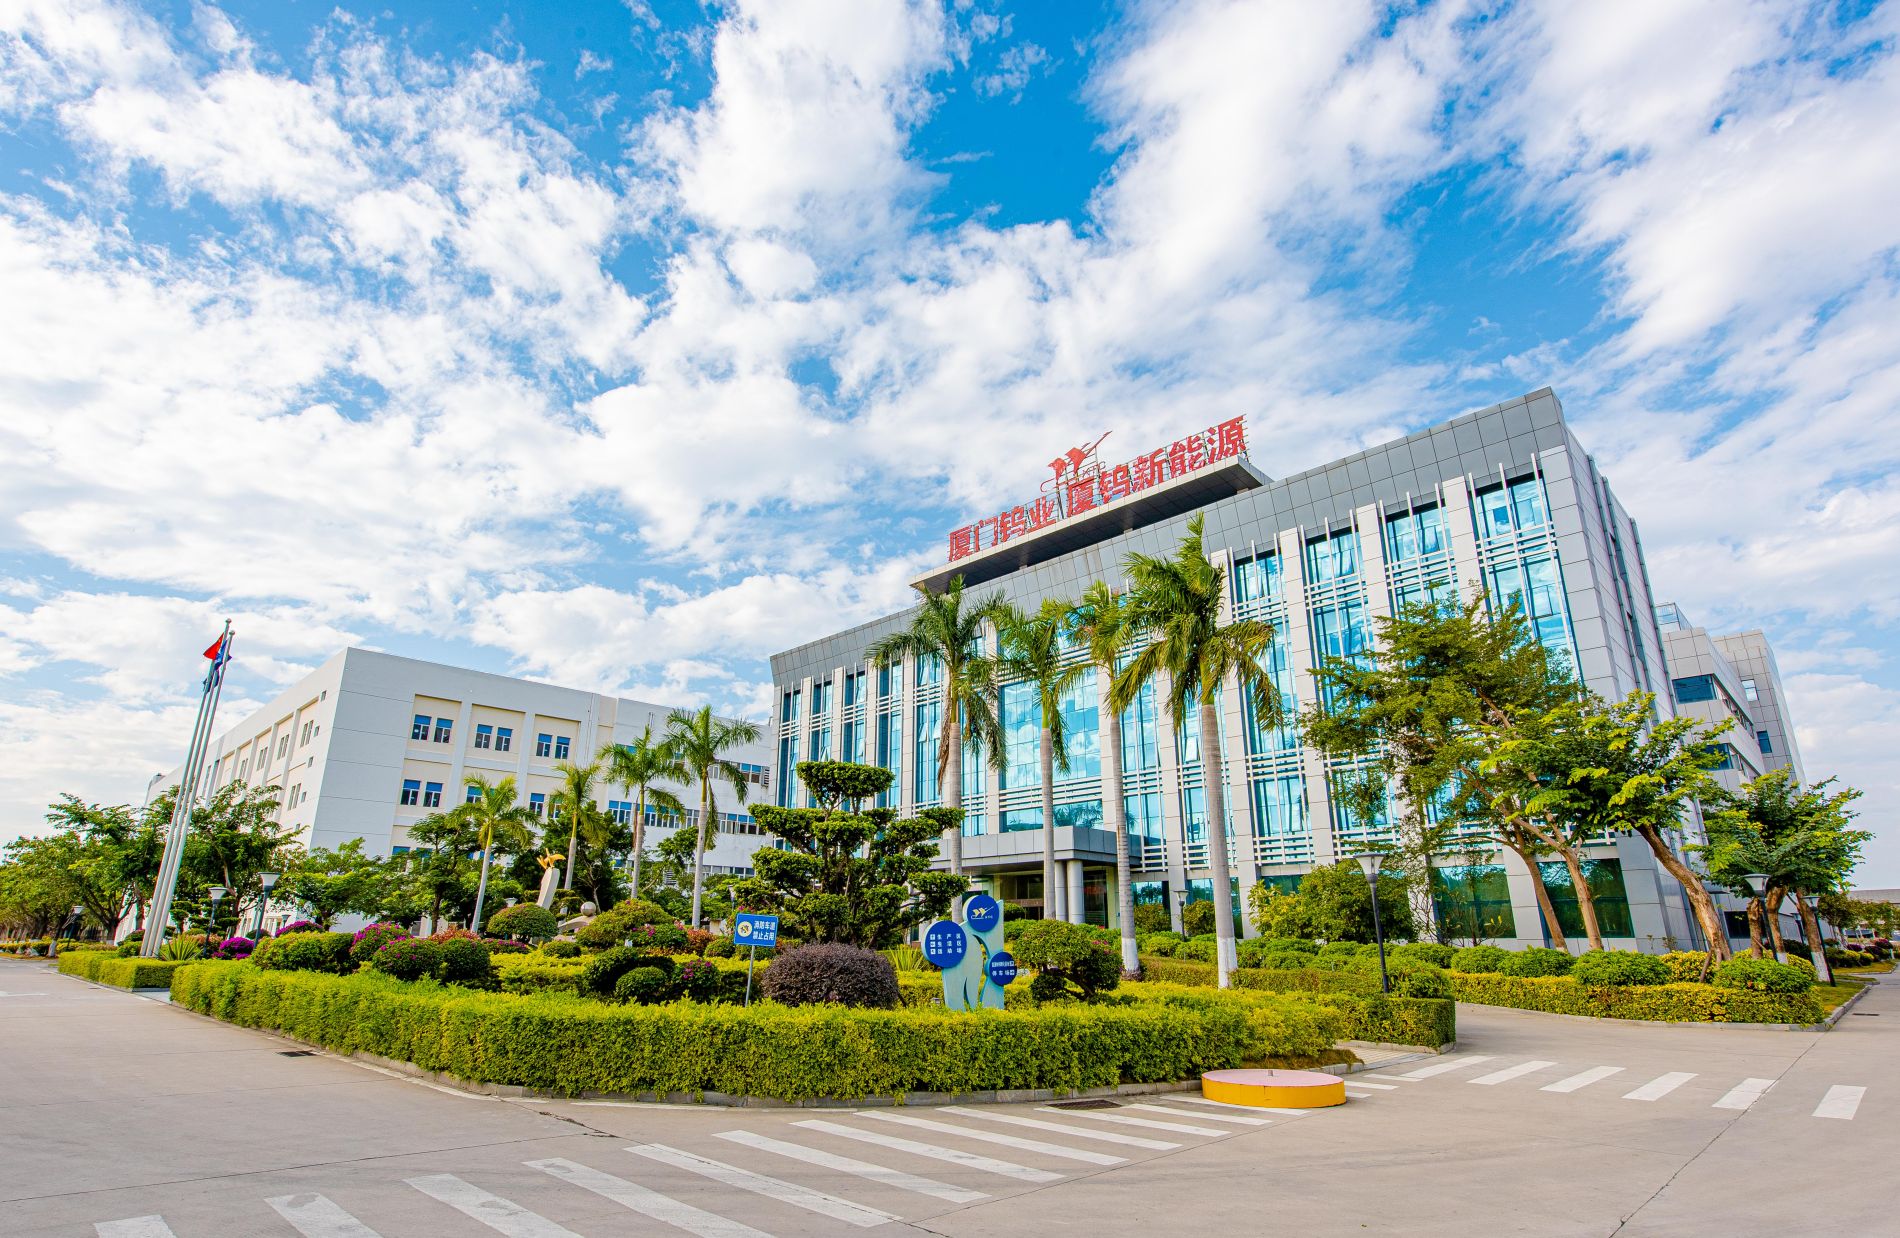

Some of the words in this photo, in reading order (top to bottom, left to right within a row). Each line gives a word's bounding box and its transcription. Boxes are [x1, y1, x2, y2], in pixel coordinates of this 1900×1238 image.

[948, 496, 1057, 562] 厦门钨业
[1067, 415, 1247, 518] 厦钨新能源
[752, 930, 775, 941] 禁止占用
